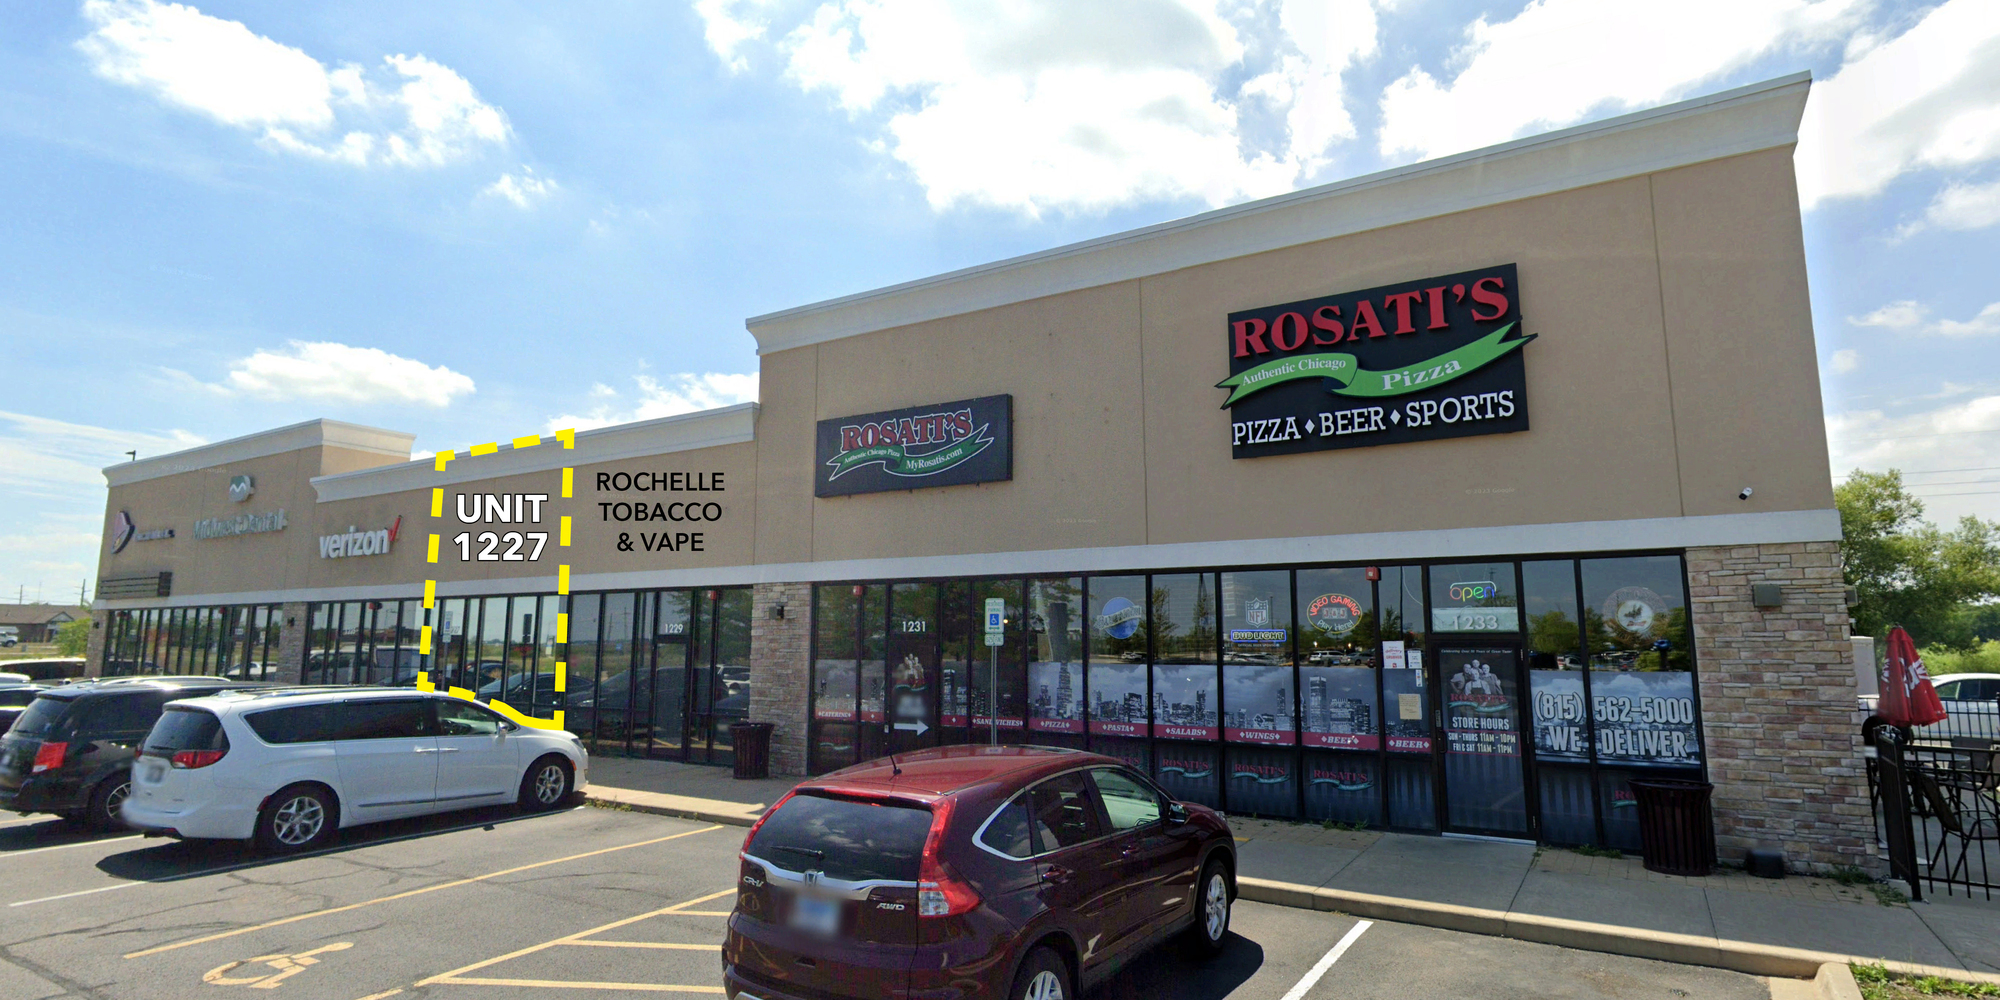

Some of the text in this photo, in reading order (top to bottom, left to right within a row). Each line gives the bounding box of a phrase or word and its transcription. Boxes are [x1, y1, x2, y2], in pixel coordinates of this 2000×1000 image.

[1231, 276, 1510, 359] ROSATI'S
[1241, 356, 1347, 387] Authentic Chicago
[1382, 358, 1462, 390] Pizza
[1232, 390, 1515, 446] PIZZA BEER SPORTS
[841, 409, 973, 452] ROSATI'S
[844, 448, 900, 464] Authentic Chicago Pizza
[906, 448, 963, 471] MyRosatis.com
[319, 525, 390, 559] verizon
[1450, 586, 1495, 602] open
[1310, 596, 1328, 616] VIDEO
[1330, 595, 1360, 616] GAMING
[1249, 610, 1266, 622] NFL
[1452, 615, 1498, 630] 1233
[664, 623, 684, 634] 1229
[902, 621, 926, 633] 1231
[1317, 620, 1332, 631] Play
[1233, 631, 1283, 640] BUD LIGHT
[1535, 691, 1694, 724] (815) 562-5000
[1107, 724, 1130, 732] PASTA
[1452, 716, 1479, 728] STORE
[1480, 717, 1510, 730] HOURS
[1170, 728, 1202, 736] SALADS
[1245, 732, 1275, 740] WINGS
[1462, 733, 1478, 741] THURS
[1480, 733, 1494, 742] 11AM
[1500, 733, 1516, 743] 10PM
[1395, 740, 1423, 748] BEER
[1548, 725, 1688, 757] WE DELIVER
[1466, 744, 1475, 752] SAT
[1477, 743, 1492, 753] 11AM
[1497, 744, 1513, 753] 11PM
[1162, 759, 1209, 769] ROSATI'S
[1235, 763, 1285, 775] ROSATI'S
[1314, 769, 1368, 782] ROSATI'S
[876, 902, 905, 911] AWD
